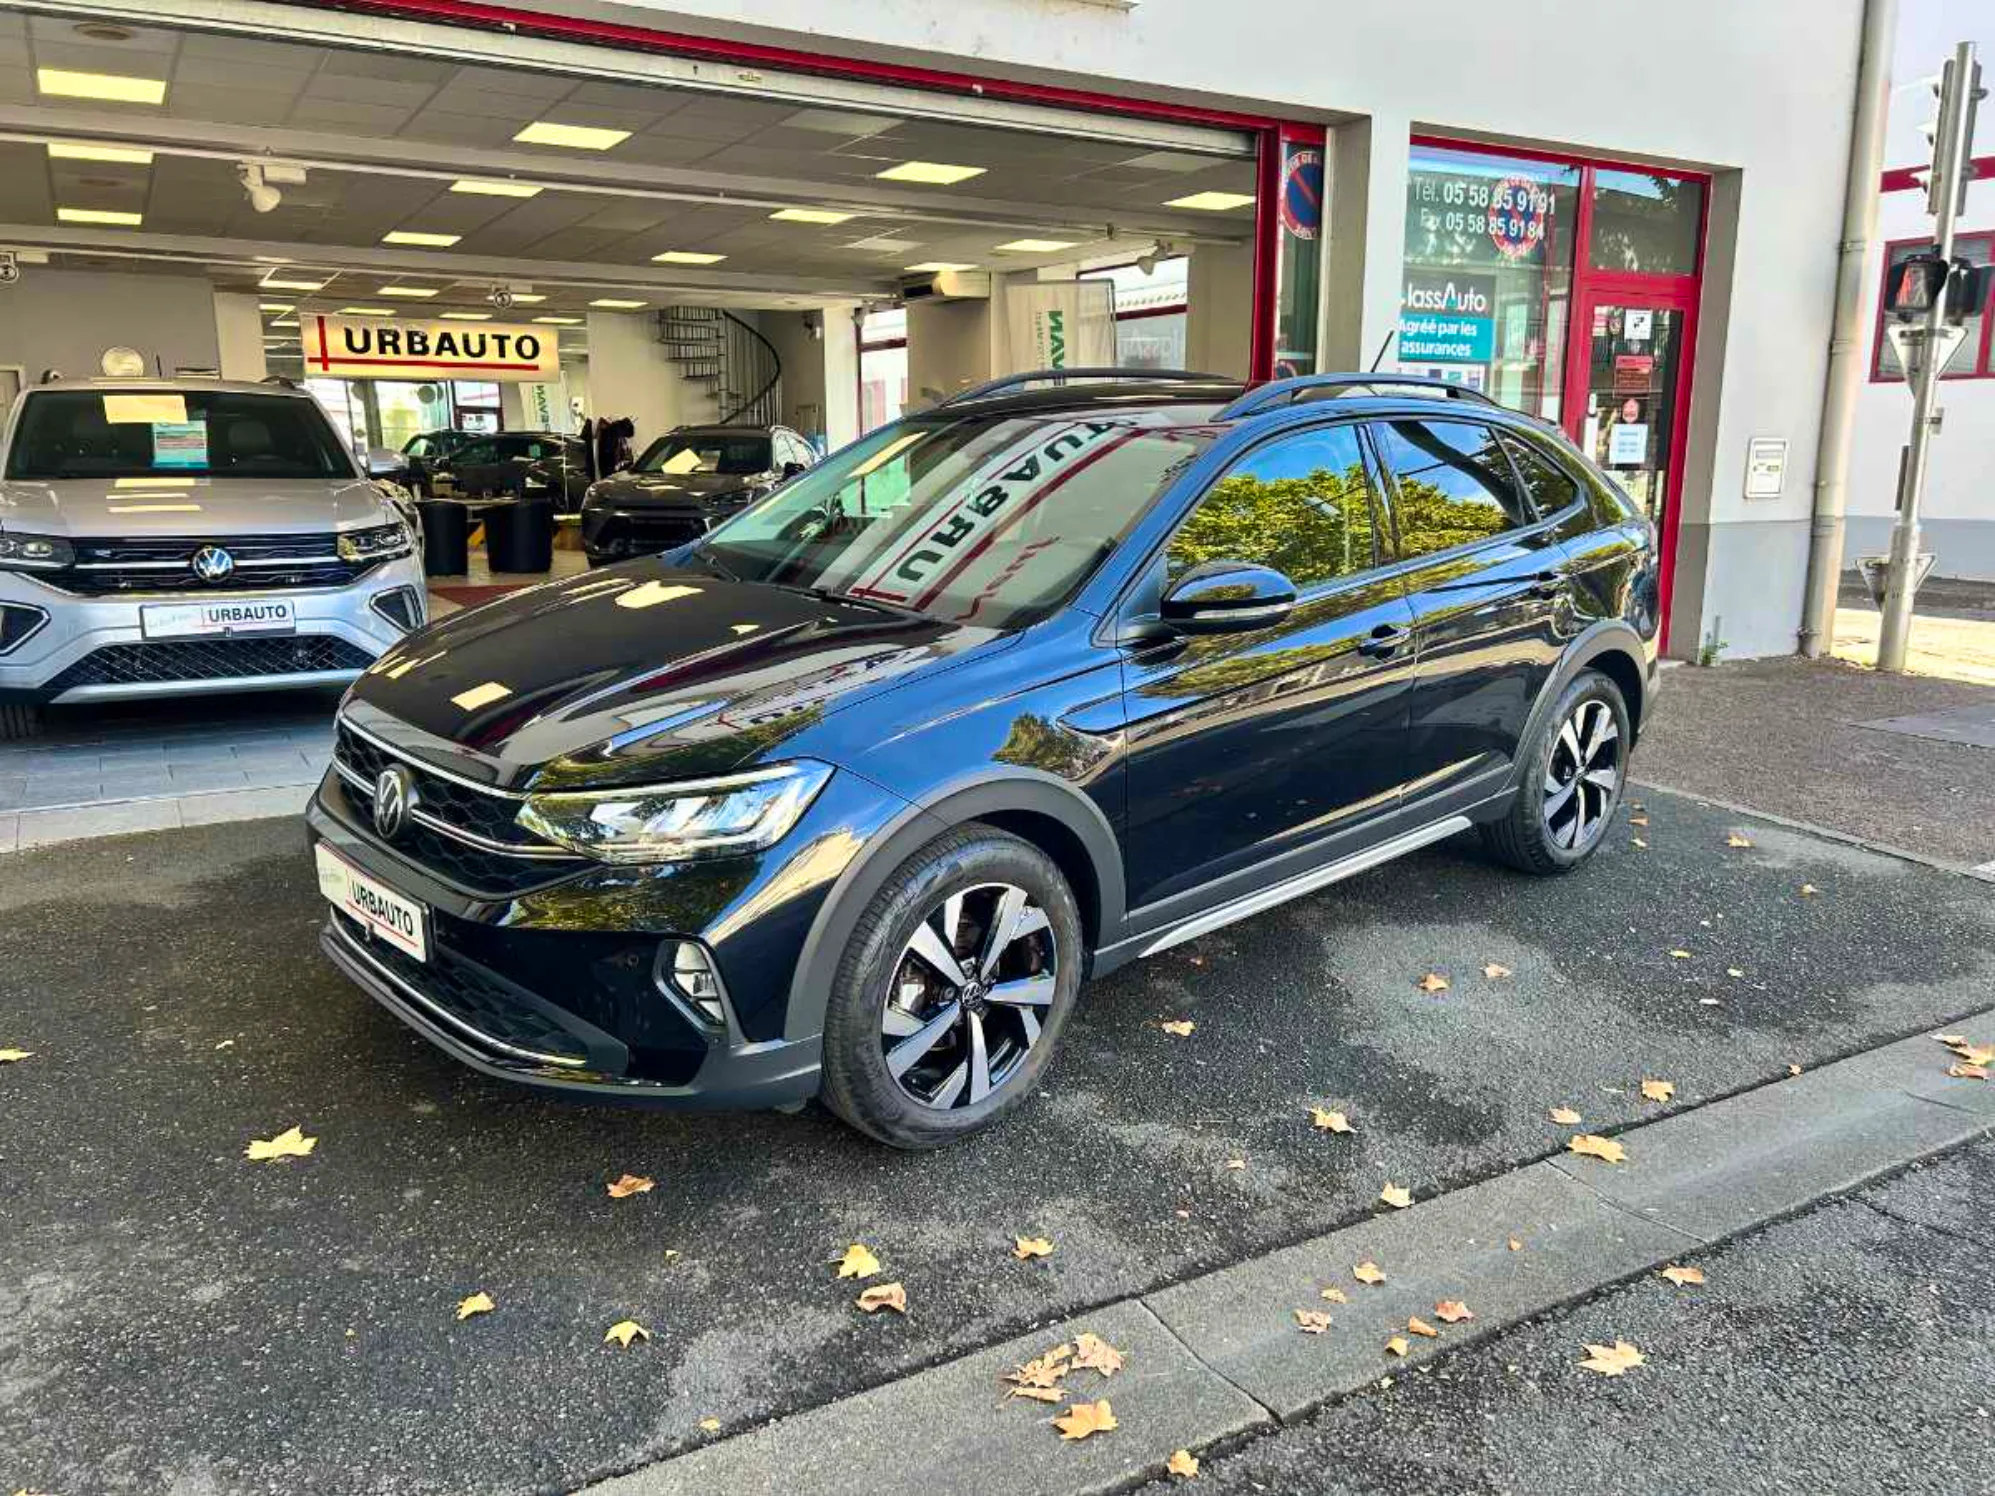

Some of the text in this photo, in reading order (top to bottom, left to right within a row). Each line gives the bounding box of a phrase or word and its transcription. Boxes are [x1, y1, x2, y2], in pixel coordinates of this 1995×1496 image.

[1443, 182, 1466, 205] 05
[1468, 184, 1489, 208] 58
[1493, 186, 1513, 211] 85
[1516, 190, 1534, 213] 91
[1536, 192, 1556, 215] 91
[1445, 212, 1464, 231] 05
[1467, 214, 1486, 234] 58
[1488, 217, 1506, 236] 85
[1509, 218, 1525, 238] 91
[1527, 221, 1544, 240] 84
[1400, 281, 1487, 312] lassAuto
[344, 325, 541, 361] URBAUTO
[1438, 322, 1459, 339] par
[1461, 321, 1477, 337] les
[1401, 340, 1472, 357] assurances
[208, 604, 287, 623] URBAUTO
[351, 879, 414, 937] URBAUTO
